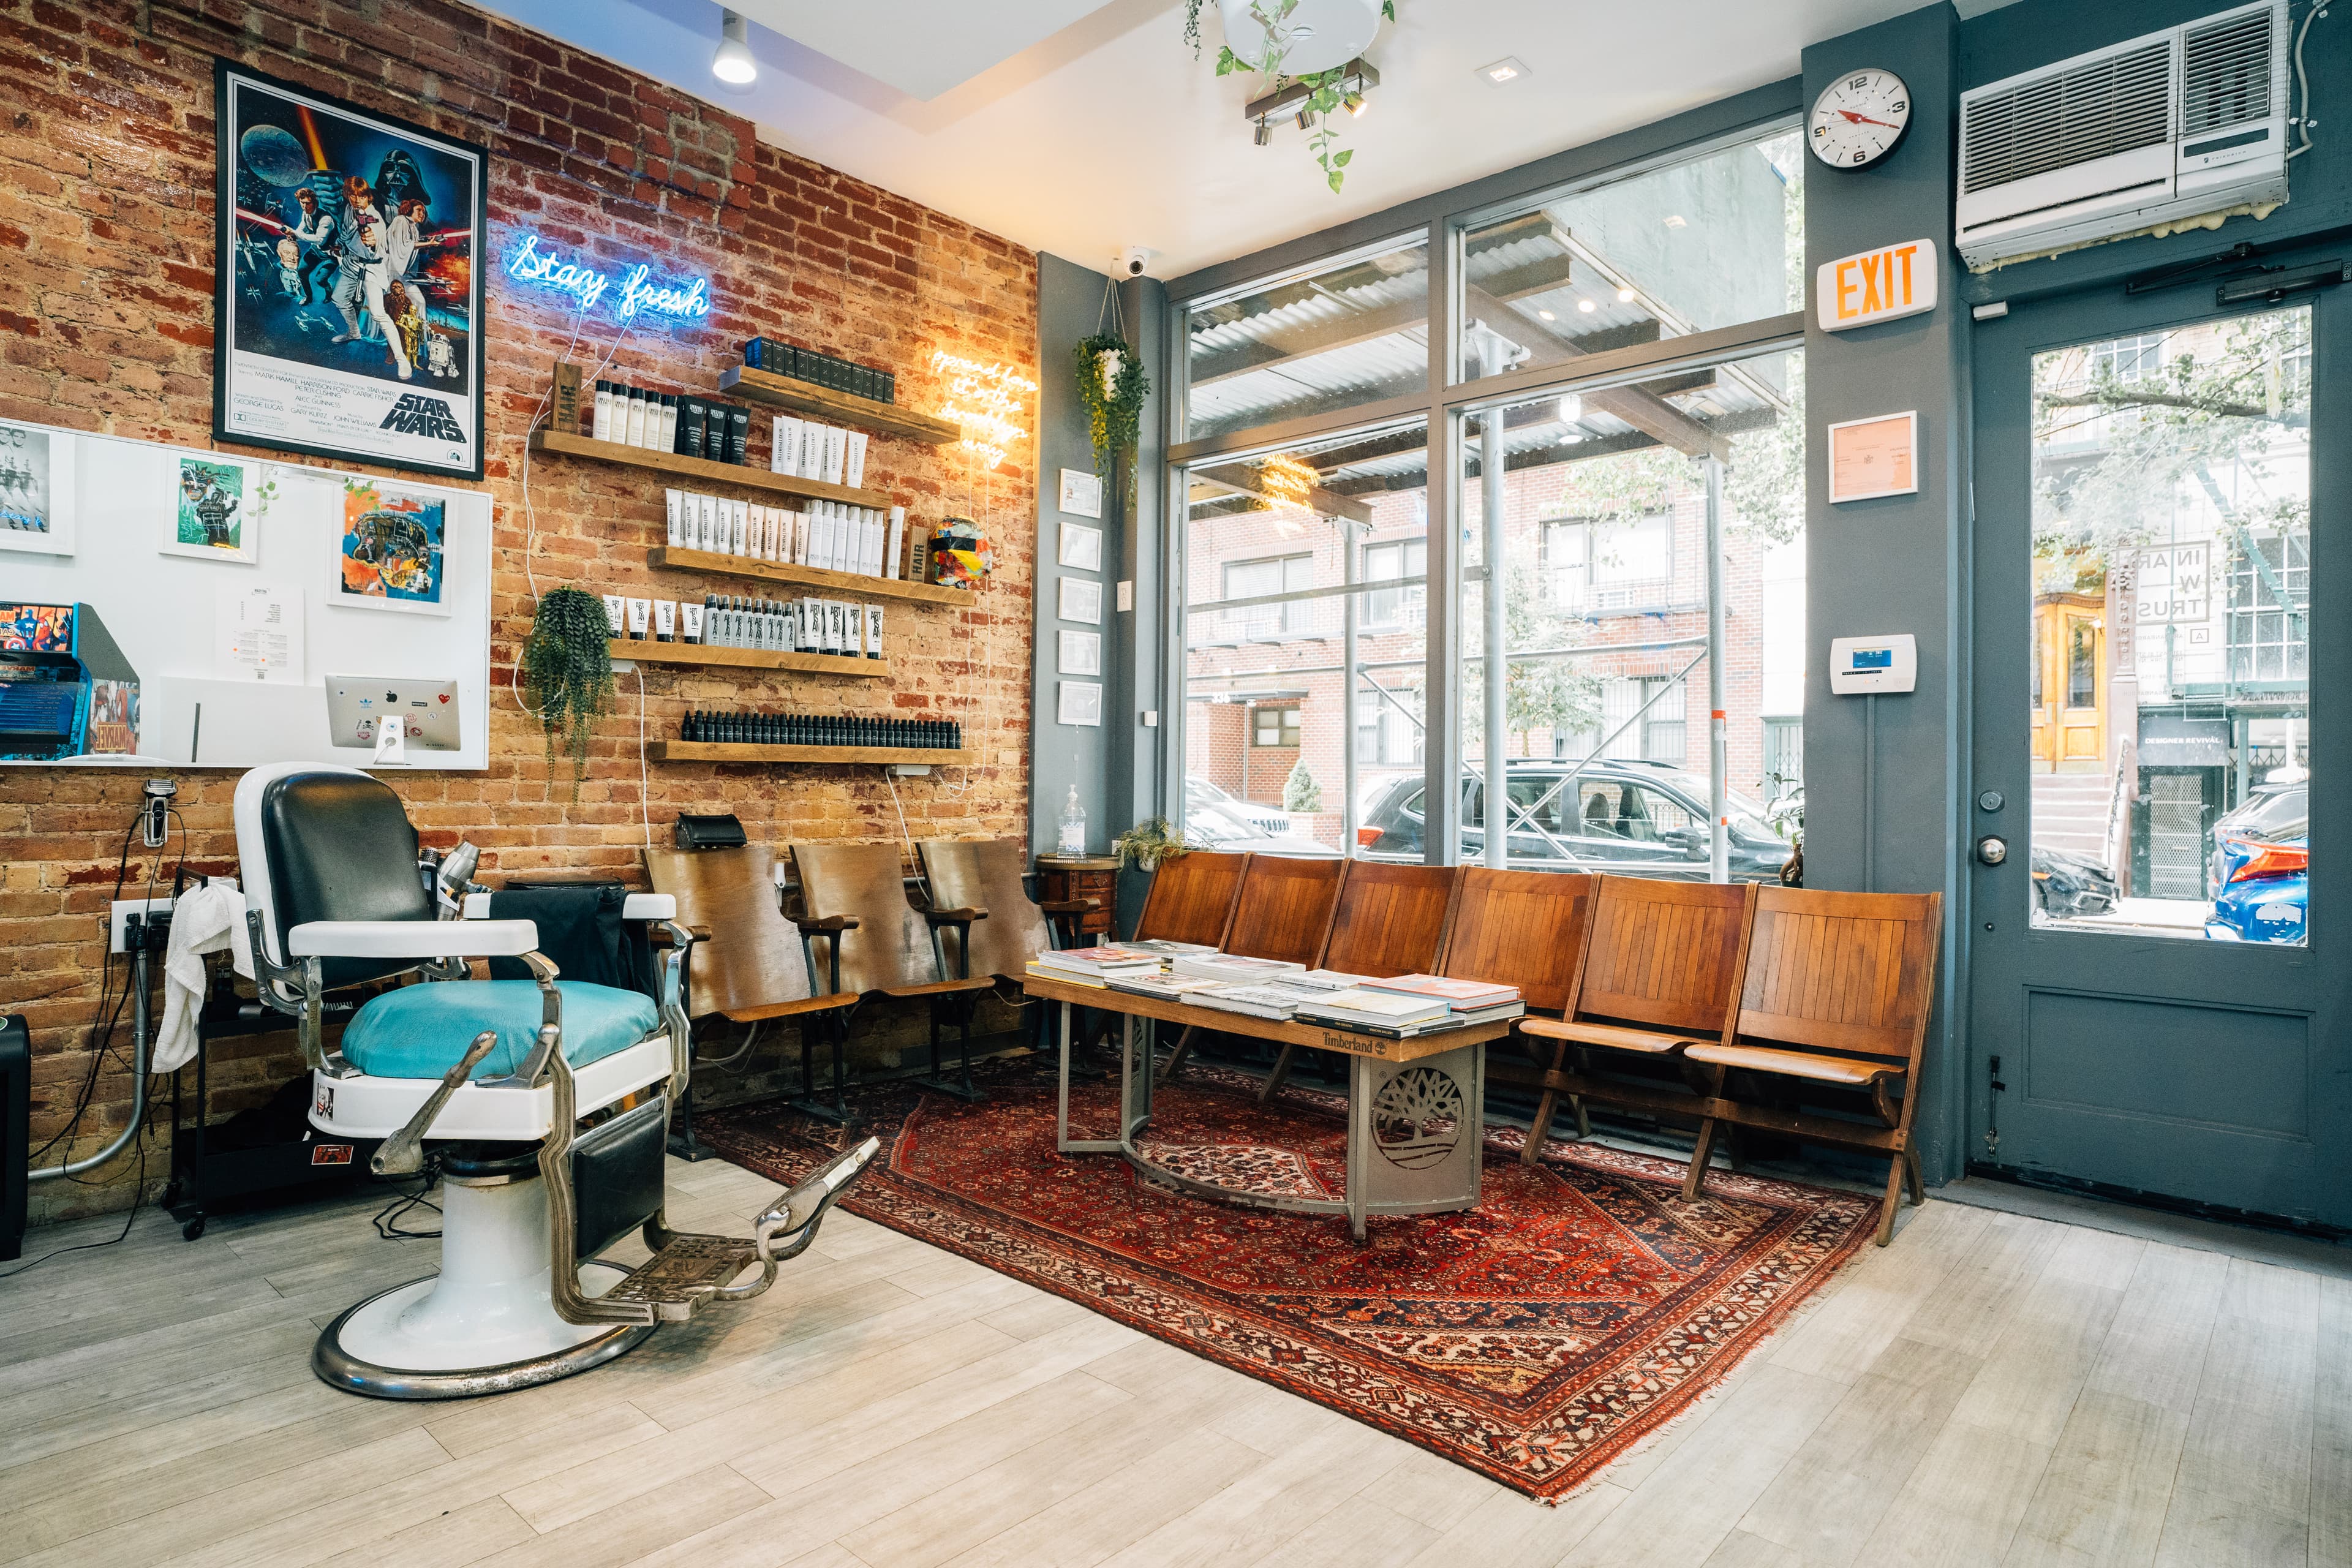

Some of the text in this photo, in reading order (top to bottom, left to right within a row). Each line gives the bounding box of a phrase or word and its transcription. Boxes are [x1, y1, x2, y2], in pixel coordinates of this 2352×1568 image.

[1849, 76, 1867, 91] 12
[1892, 100, 1905, 113] 3
[1814, 126, 1826, 138] 9
[1853, 151, 1866, 162] 6
[509, 235, 710, 317] Stay fresh
[1836, 245, 1917, 320] EXIT
[254, 371, 274, 380] MARK
[276, 374, 298, 385] HAMILL
[301, 379, 331, 390] HARRISON
[333, 385, 350, 394] FORD
[295, 385, 341, 399] PETER CUSHING
[233, 398, 284, 412] GEORGE LUCAS
[295, 395, 341, 409] ALEC GUINNESS
[394, 393, 455, 420] STAR
[290, 407, 307, 416] GARY
[309, 410, 328, 419] KURTZ
[350, 418, 377, 428] WILLIAMS
[379, 409, 467, 443] WARS
[912, 544, 924, 575] HAIR
[1323, 1031, 1373, 1053] Timberland
